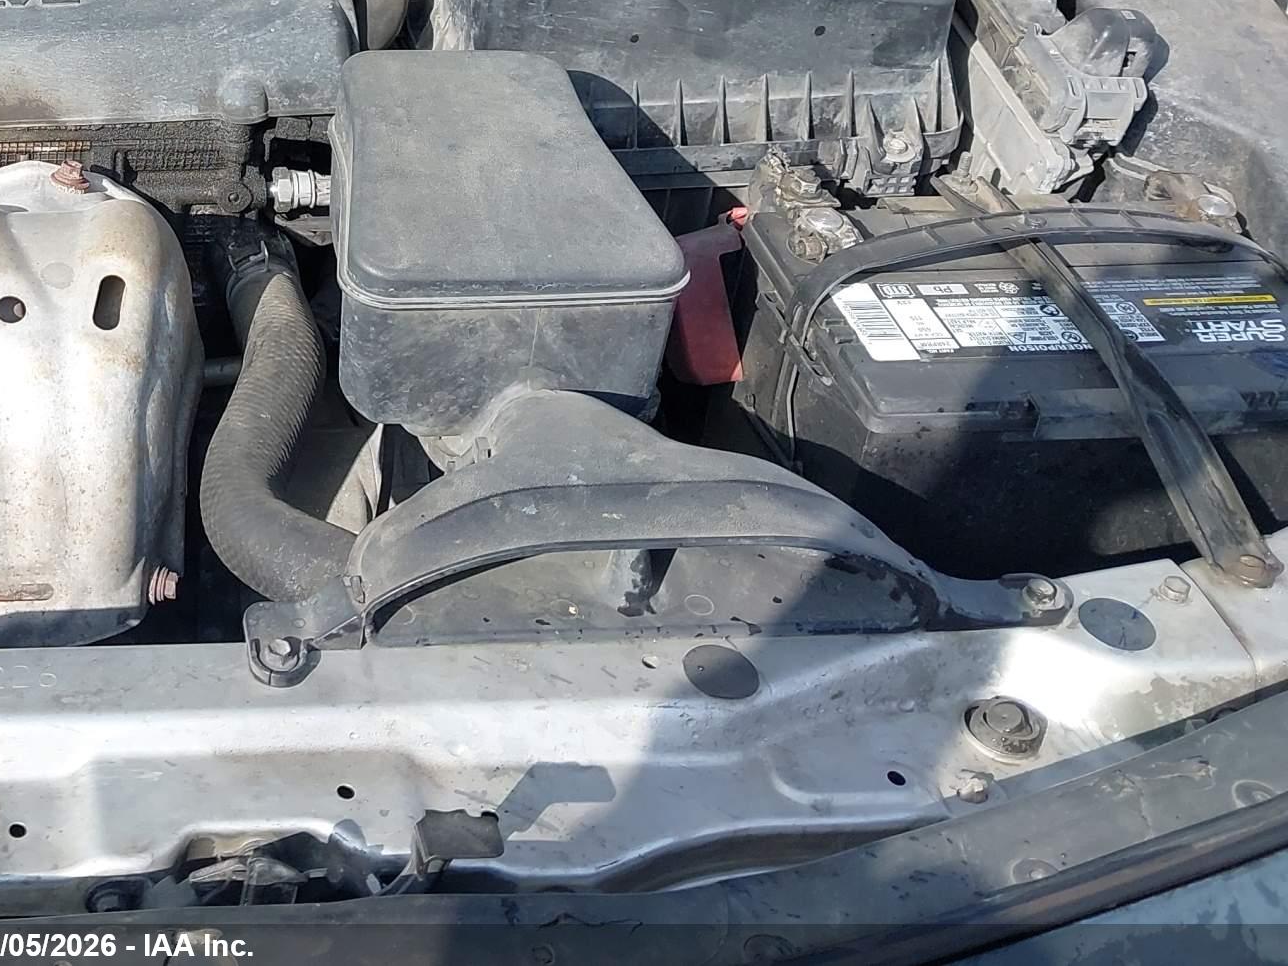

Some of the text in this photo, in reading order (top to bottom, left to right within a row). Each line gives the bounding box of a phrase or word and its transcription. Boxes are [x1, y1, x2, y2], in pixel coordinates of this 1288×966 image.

[1191, 319, 1287, 334] START
[1196, 330, 1286, 343] SUPER
[1008, 342, 1094, 353] NGER/POISON
